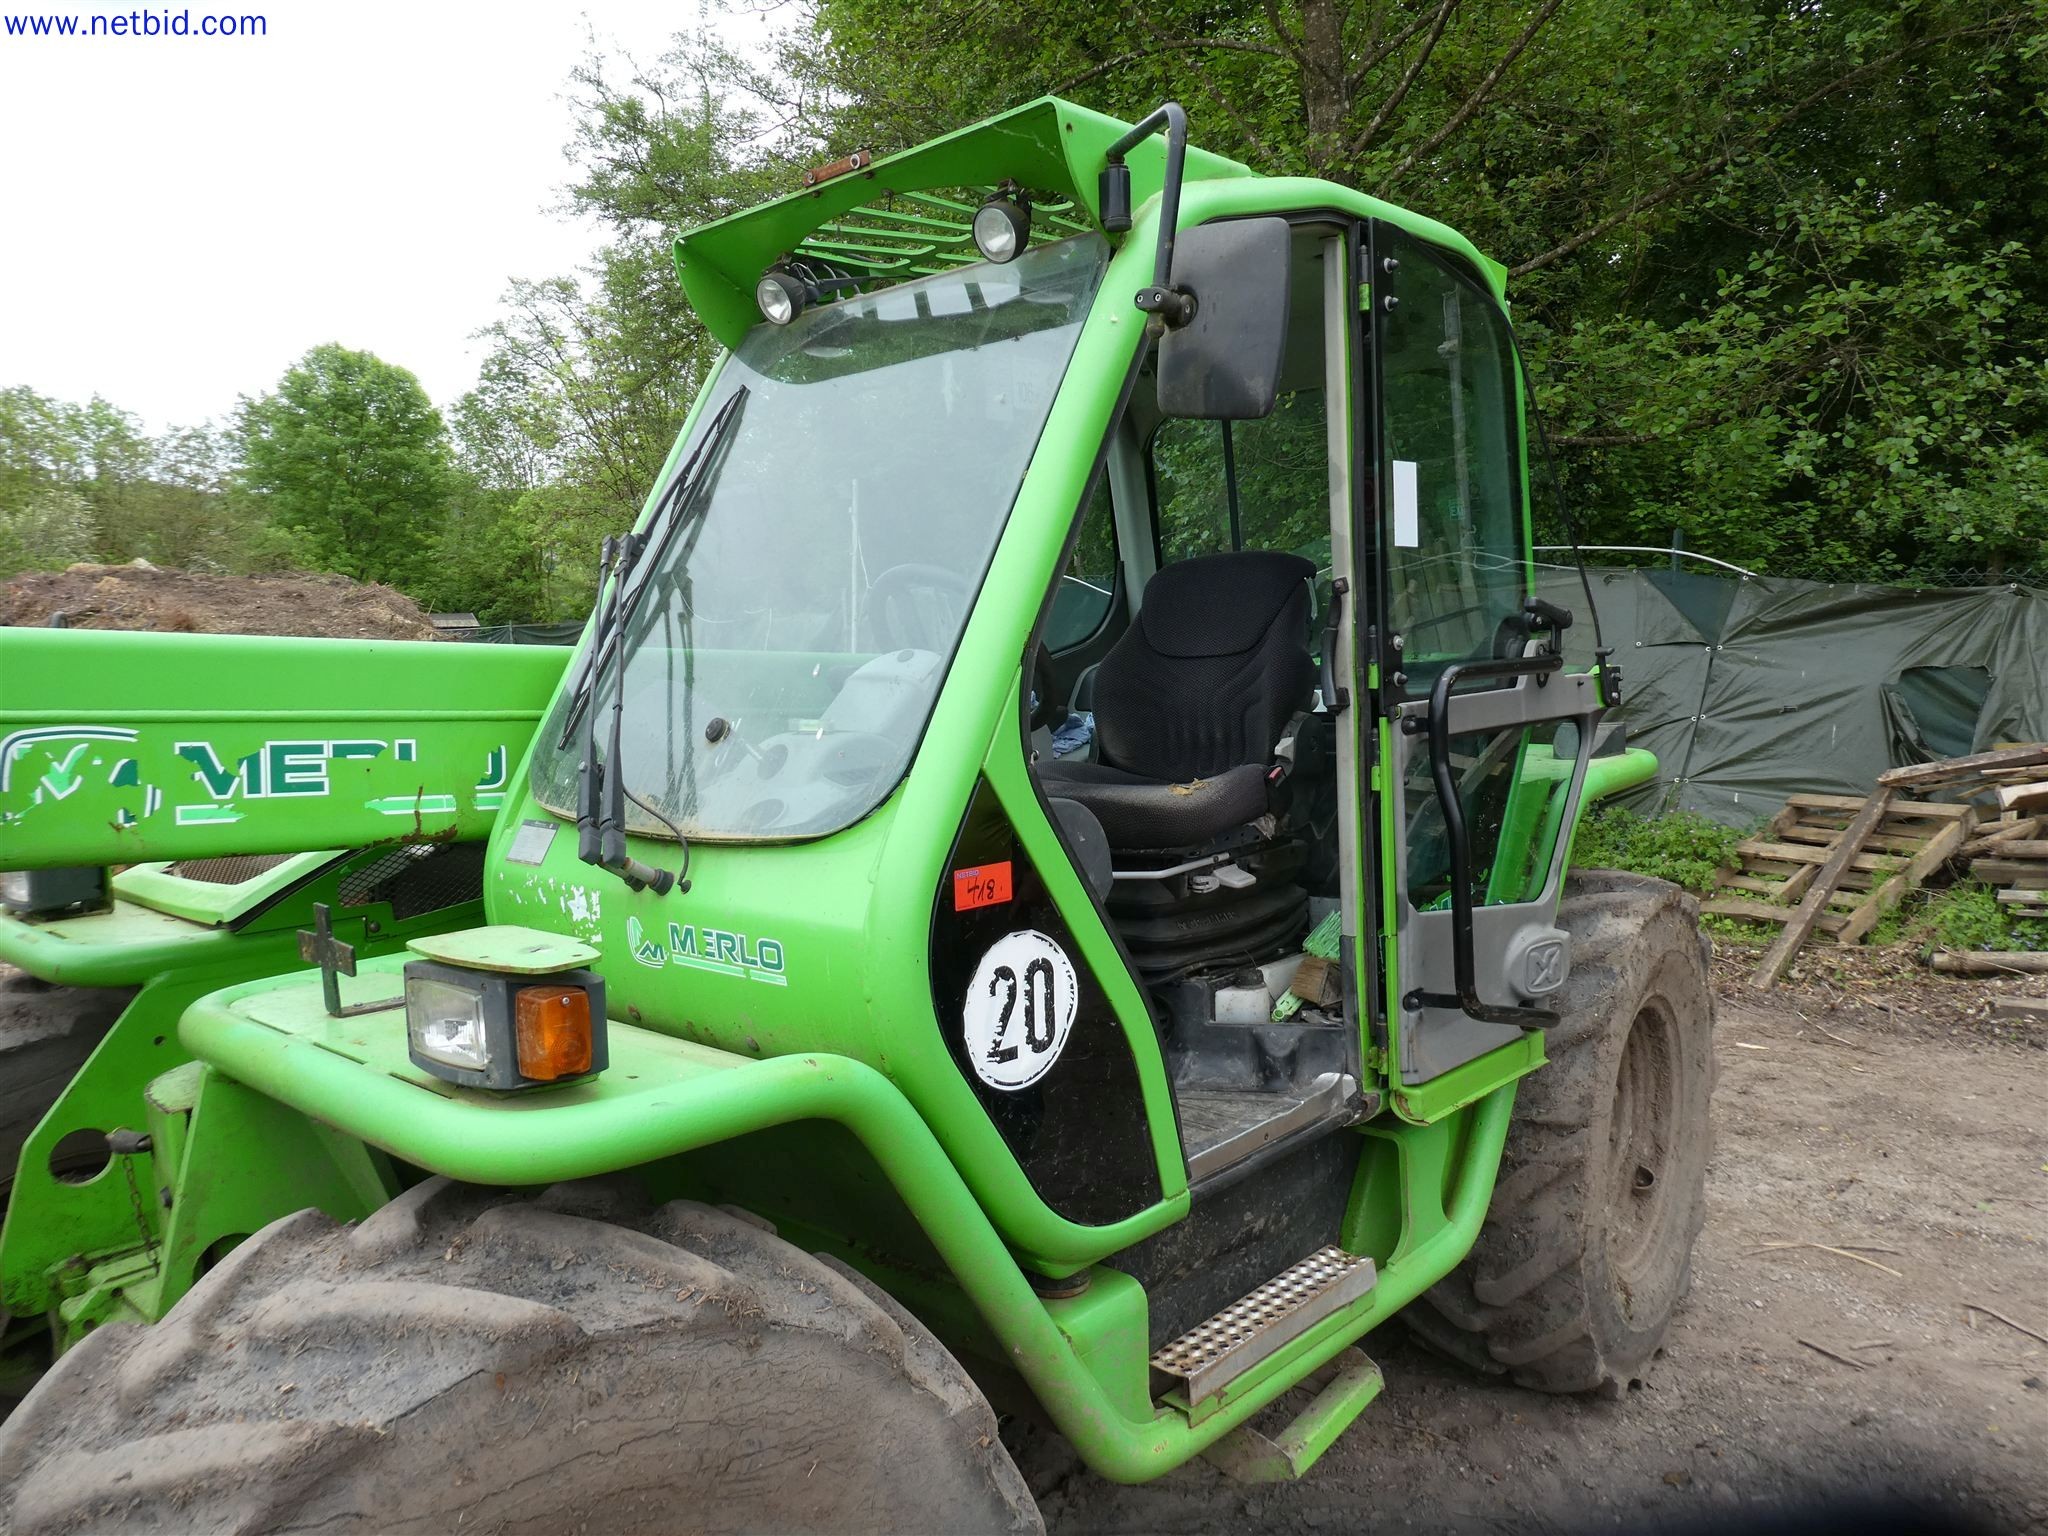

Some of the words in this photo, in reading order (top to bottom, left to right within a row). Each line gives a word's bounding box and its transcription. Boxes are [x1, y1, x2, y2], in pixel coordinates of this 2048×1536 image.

[967, 876, 996, 904] 418
[668, 921, 785, 973] MERLO
[986, 956, 1056, 1065] 20
